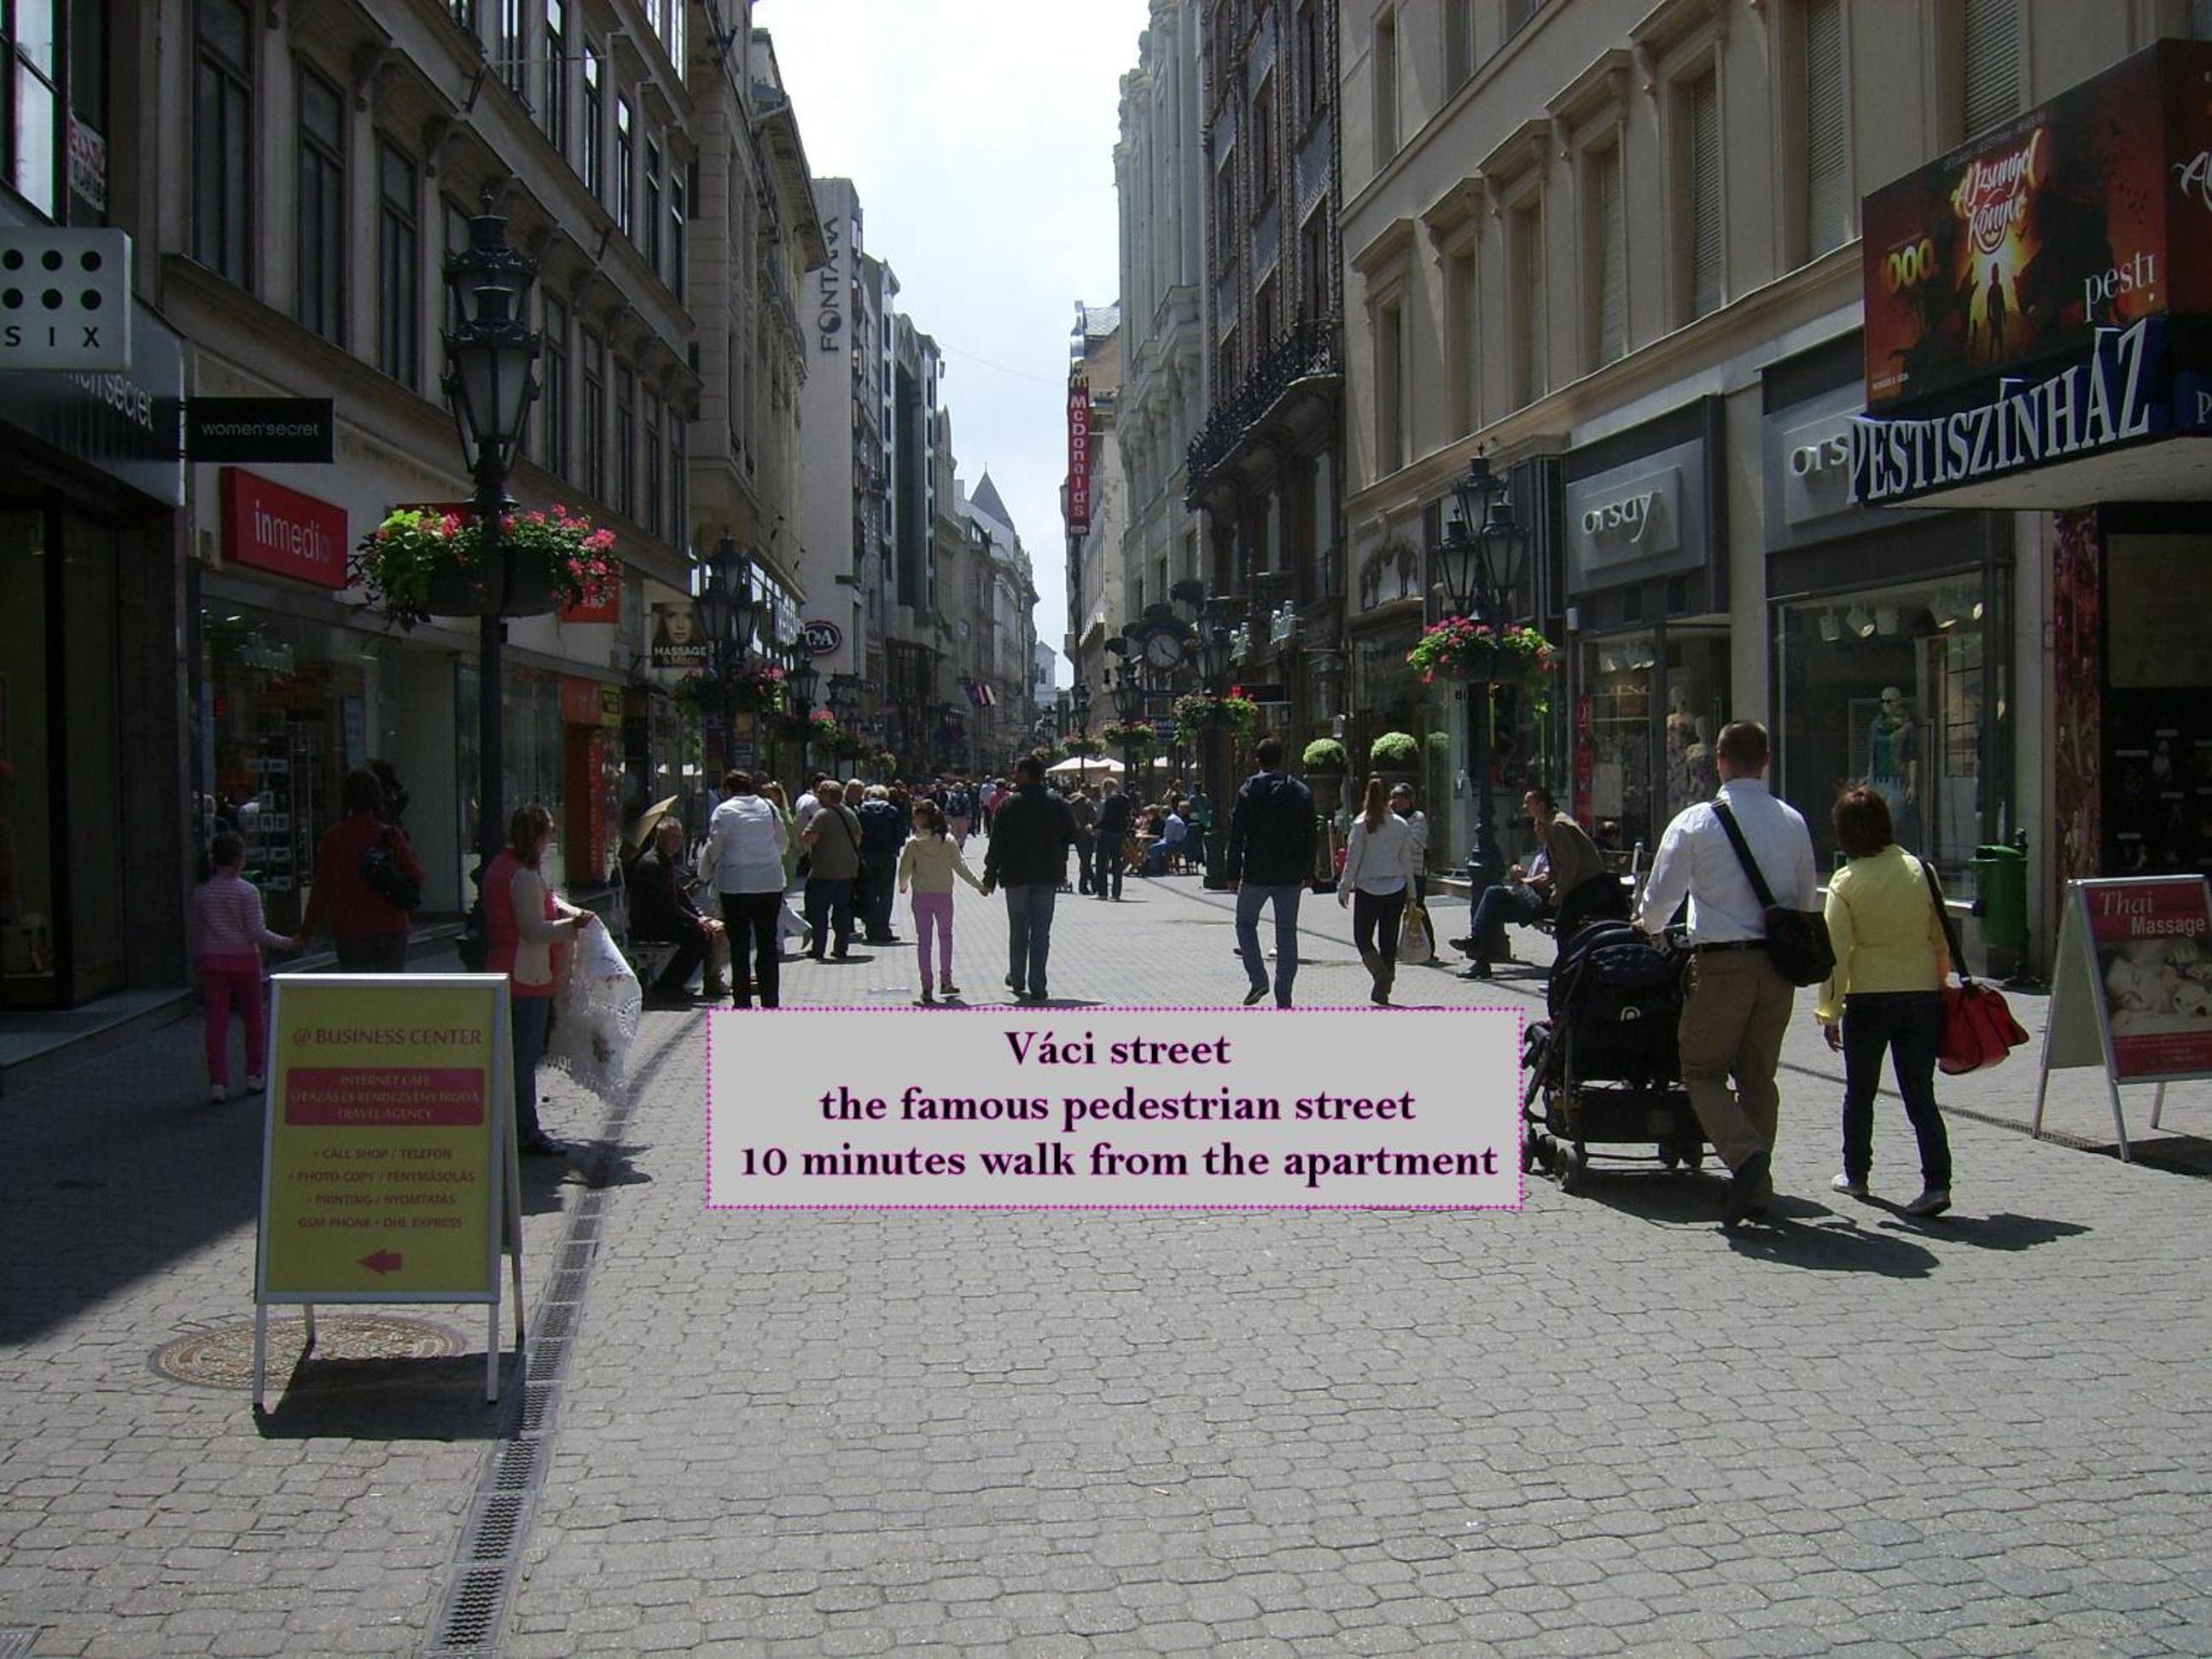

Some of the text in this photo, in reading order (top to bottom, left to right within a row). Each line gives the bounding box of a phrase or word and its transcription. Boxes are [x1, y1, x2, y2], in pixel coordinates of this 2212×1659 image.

[4, 326, 101, 347] SIX
[200, 422, 322, 438] women'secret
[1790, 432, 1850, 477] ors
[1580, 488, 1662, 544] orsay
[254, 498, 332, 565] inmedio
[654, 645, 707, 657] MASSAGE
[2098, 889, 2155, 917] Thai
[2131, 915, 2207, 938] Massage
[315, 1028, 405, 1045] BUSINESS
[410, 1028, 482, 1045] CENTER
[321, 1148, 352, 1161] CALL
[354, 1147, 388, 1161] SHOP
[400, 1147, 452, 1161] TELEFON
[296, 1170, 340, 1183] PHOTO
[342, 1170, 375, 1183] COPY
[315, 1194, 372, 1206] PRINTING
[329, 1216, 370, 1228] PHONE
[412, 1216, 463, 1228] EXPRESS
